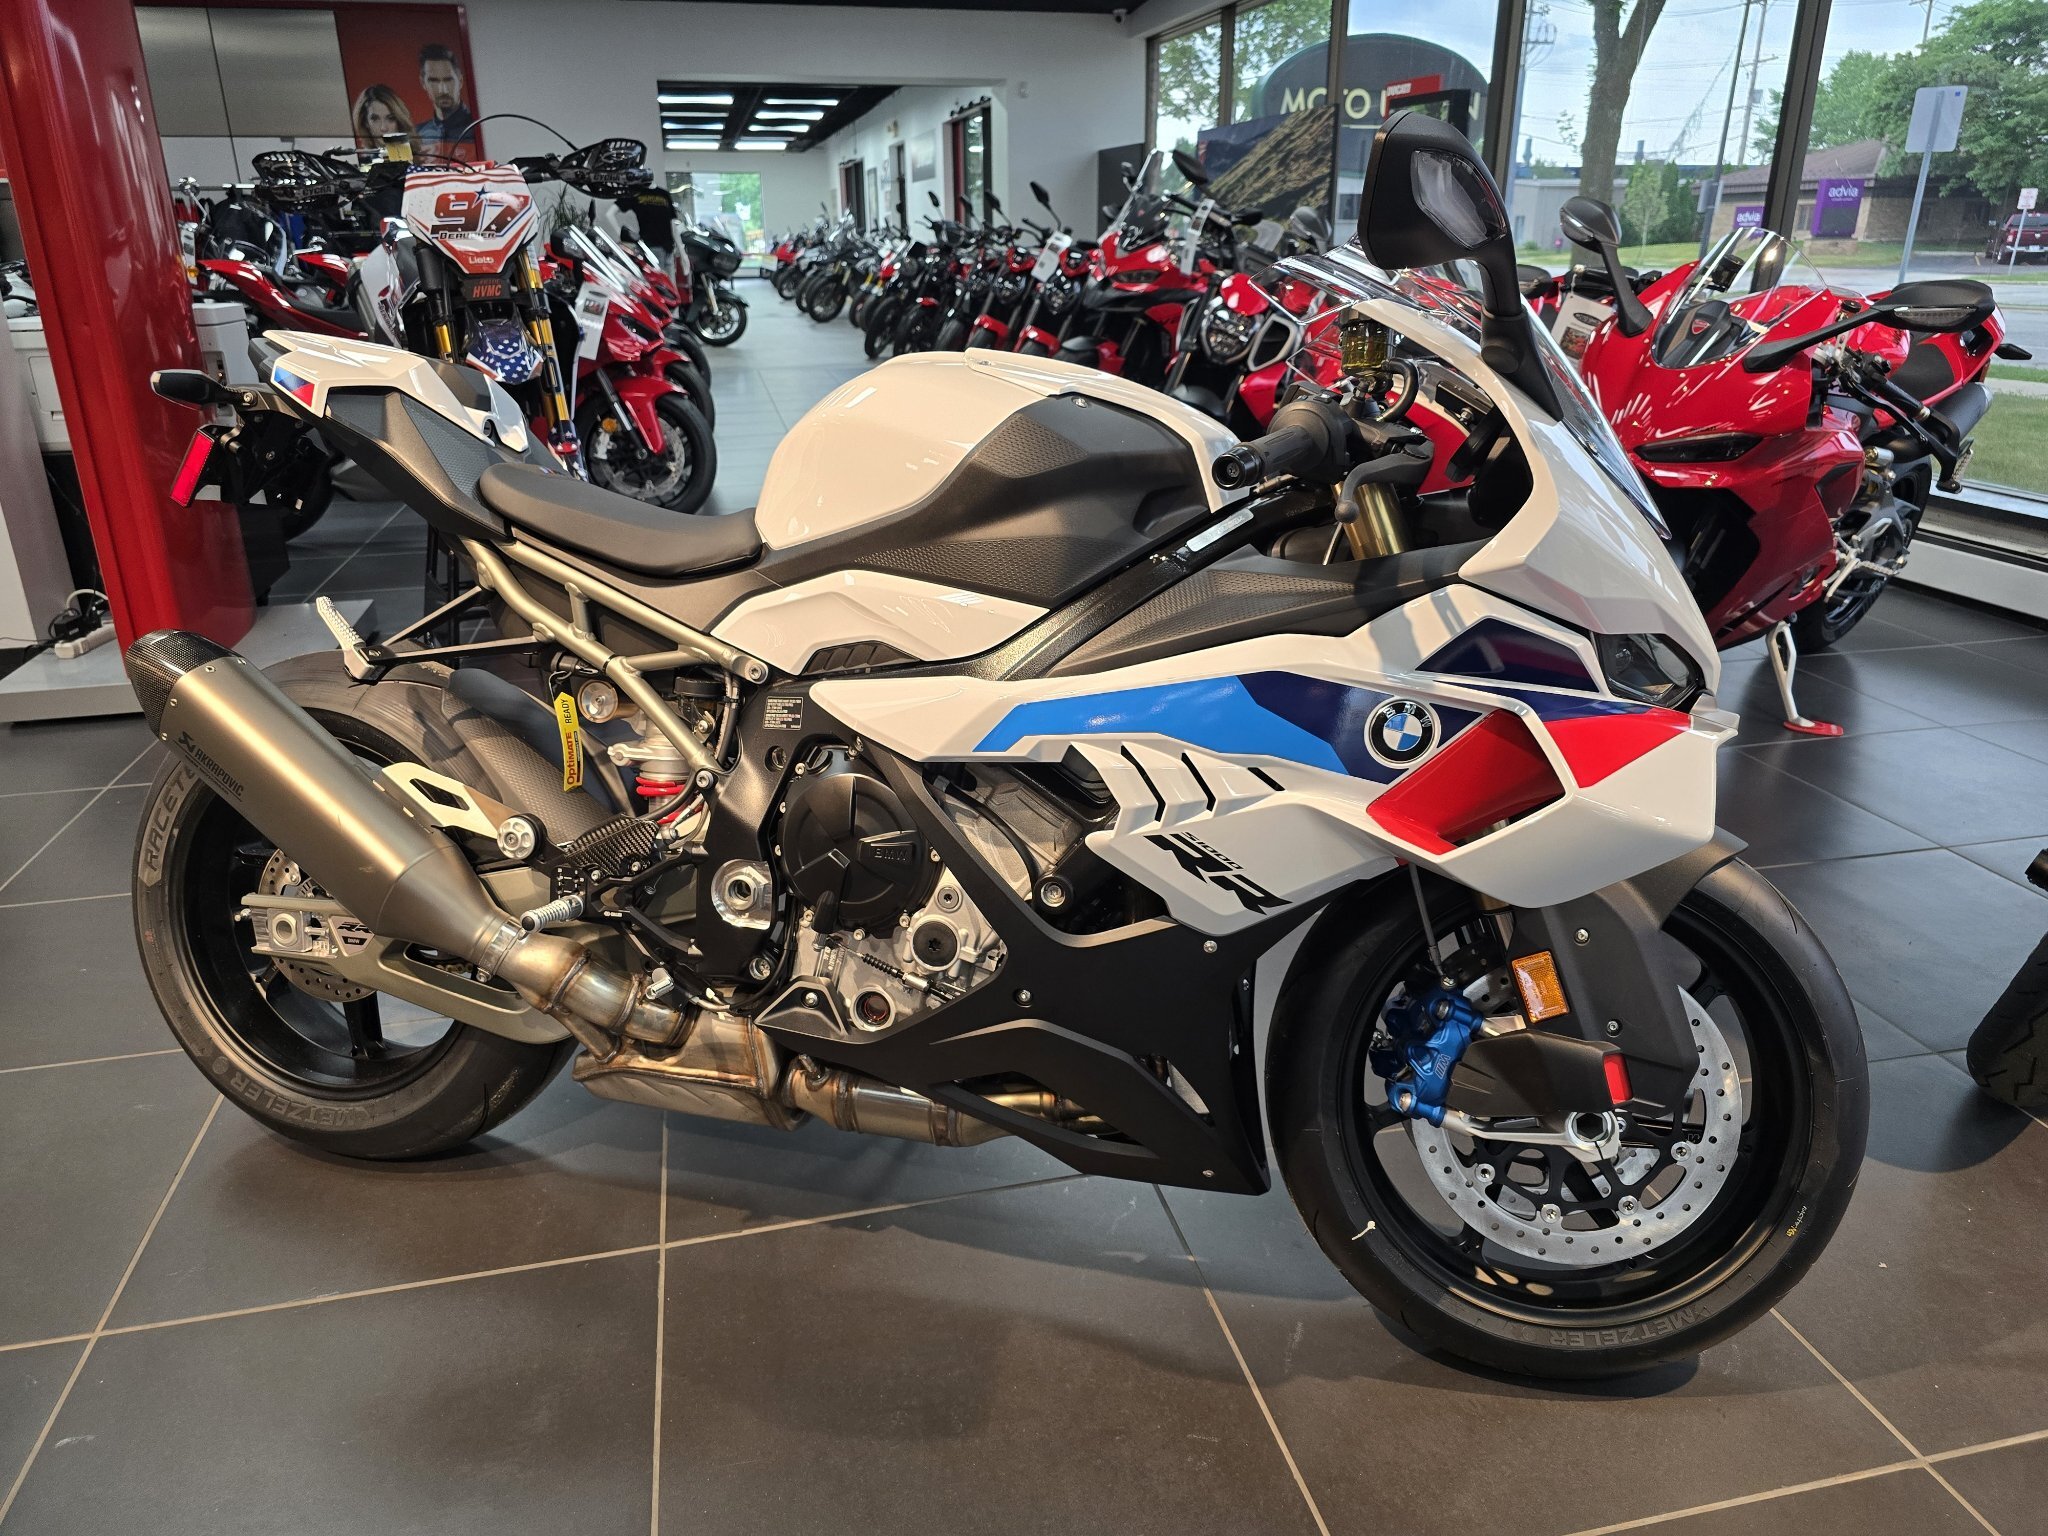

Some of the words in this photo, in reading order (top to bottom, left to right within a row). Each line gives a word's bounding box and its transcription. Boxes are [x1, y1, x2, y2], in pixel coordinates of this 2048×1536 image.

[1828, 186, 1859, 198] advia
[431, 191, 532, 237] 97
[473, 285, 501, 297] HVMC
[561, 698, 573, 724] READY
[1143, 833, 1293, 916] RR
[1550, 1308, 1697, 1347] METZELER
